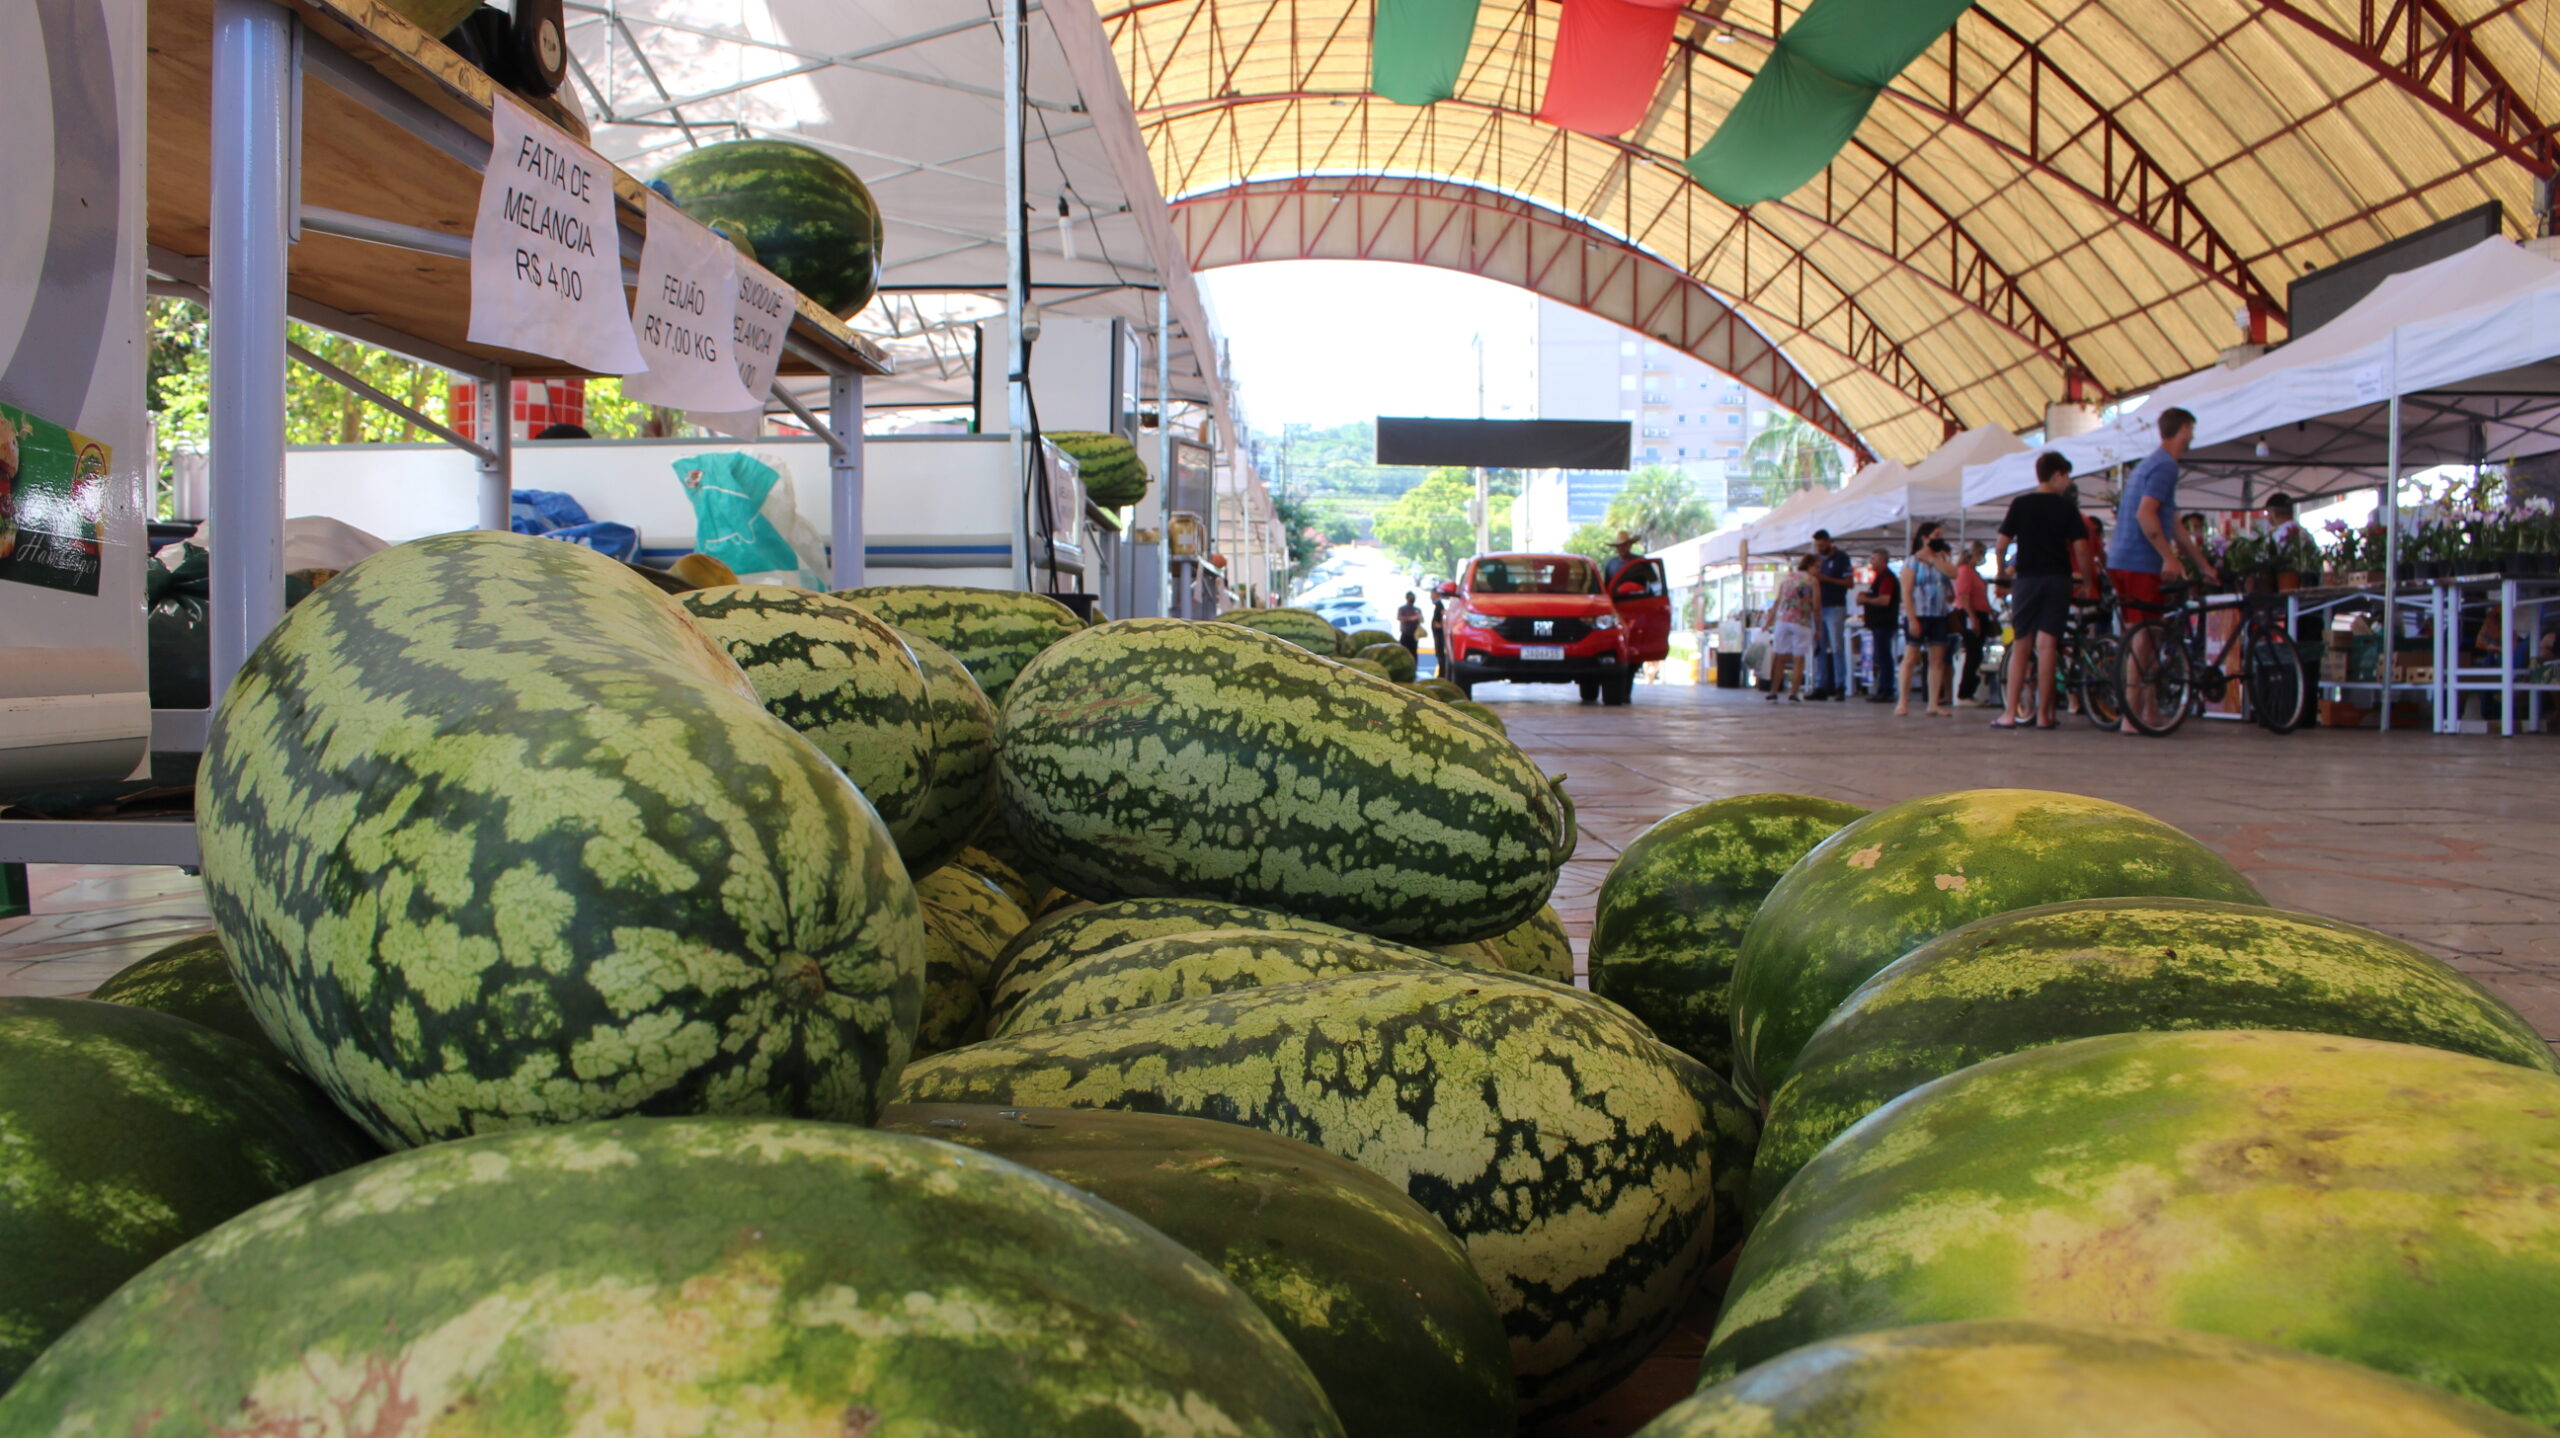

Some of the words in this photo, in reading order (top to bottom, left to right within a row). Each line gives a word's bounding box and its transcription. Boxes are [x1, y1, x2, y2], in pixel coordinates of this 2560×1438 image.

[517, 135, 566, 191] FATIA
[570, 164, 591, 204] DE
[503, 186, 595, 257] MELANCIA
[516, 248, 542, 288] R$
[547, 262, 582, 301] 4,00
[662, 274, 705, 316] FEIJÃO
[739, 276, 769, 310] SUCO
[765, 291, 783, 318] DE
[644, 314, 661, 346] R$
[665, 322, 691, 356] 7,00
[694, 333, 716, 362] KG
[733, 314, 772, 356] ELANCIA
[16, 532, 98, 586] Hamger
